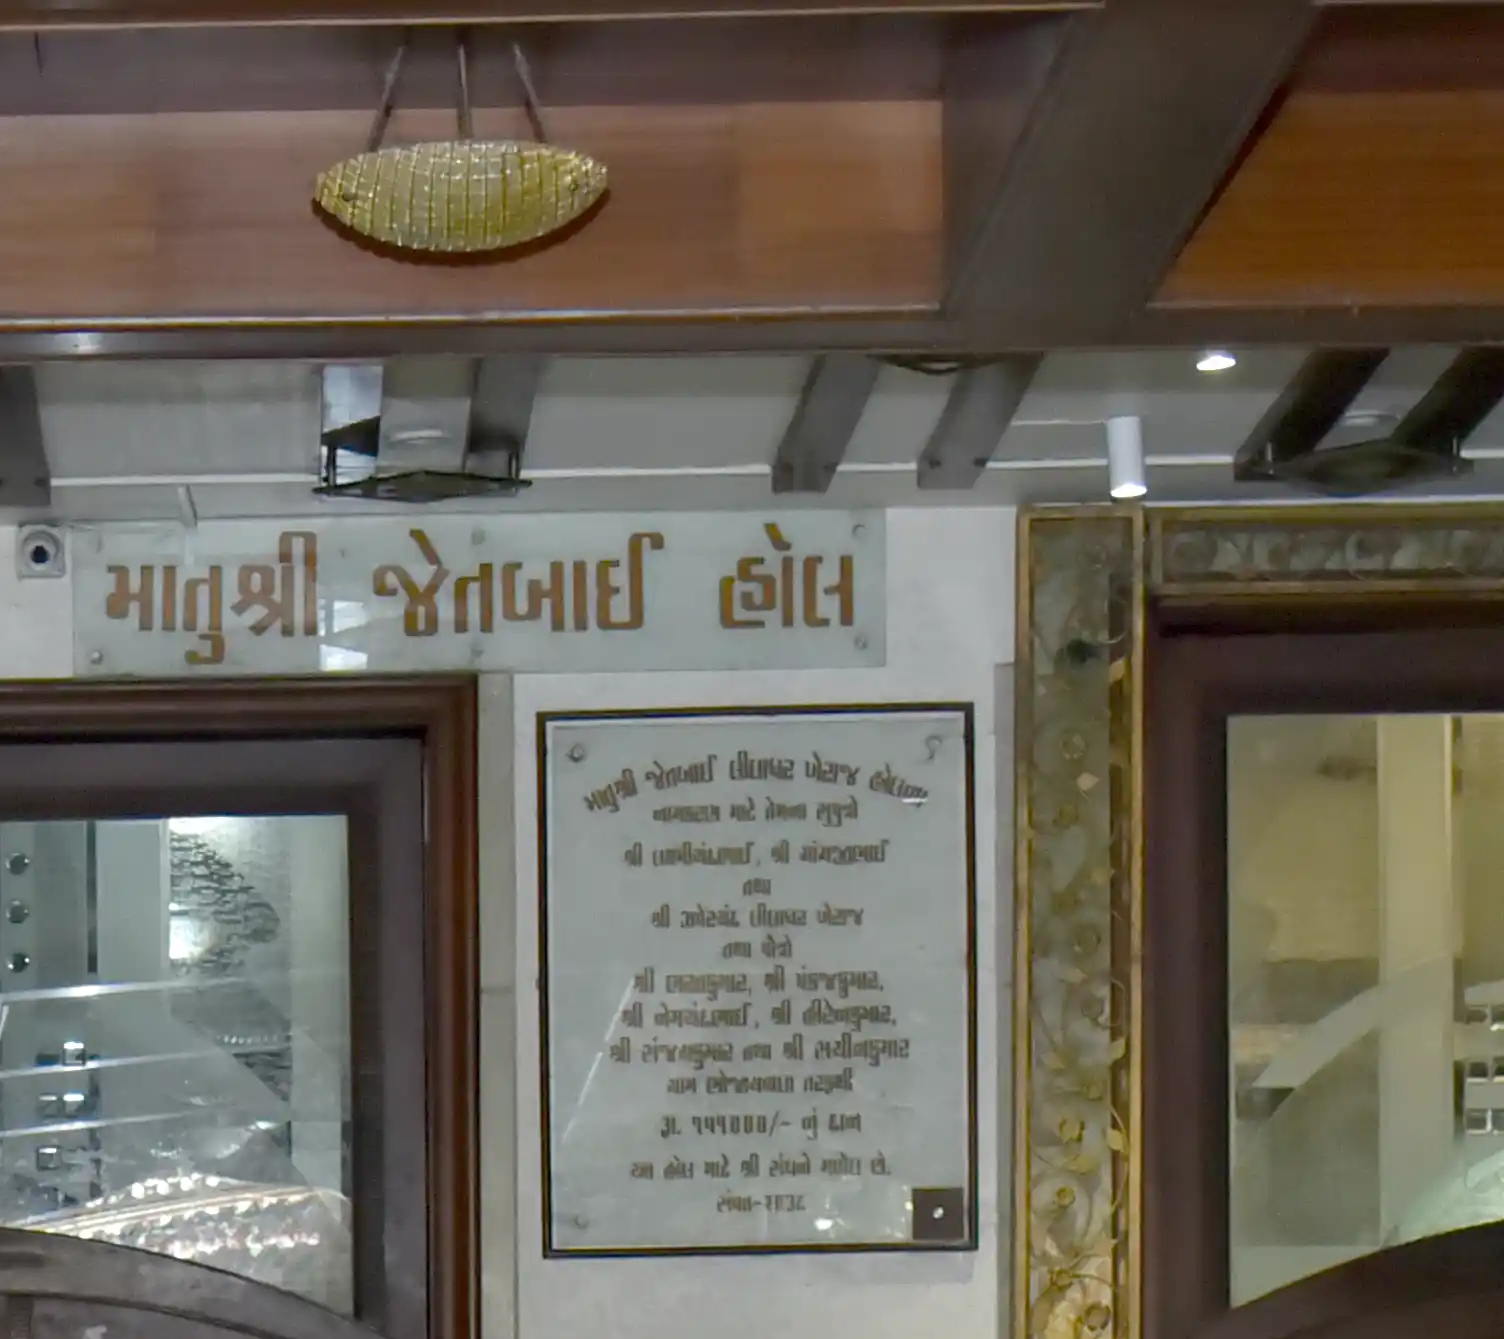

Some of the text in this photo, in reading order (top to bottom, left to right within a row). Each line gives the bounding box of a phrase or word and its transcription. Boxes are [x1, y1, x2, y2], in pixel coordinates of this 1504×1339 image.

[106, 522, 854, 665] માતુશ્રી જેતબાઈ હોલ
